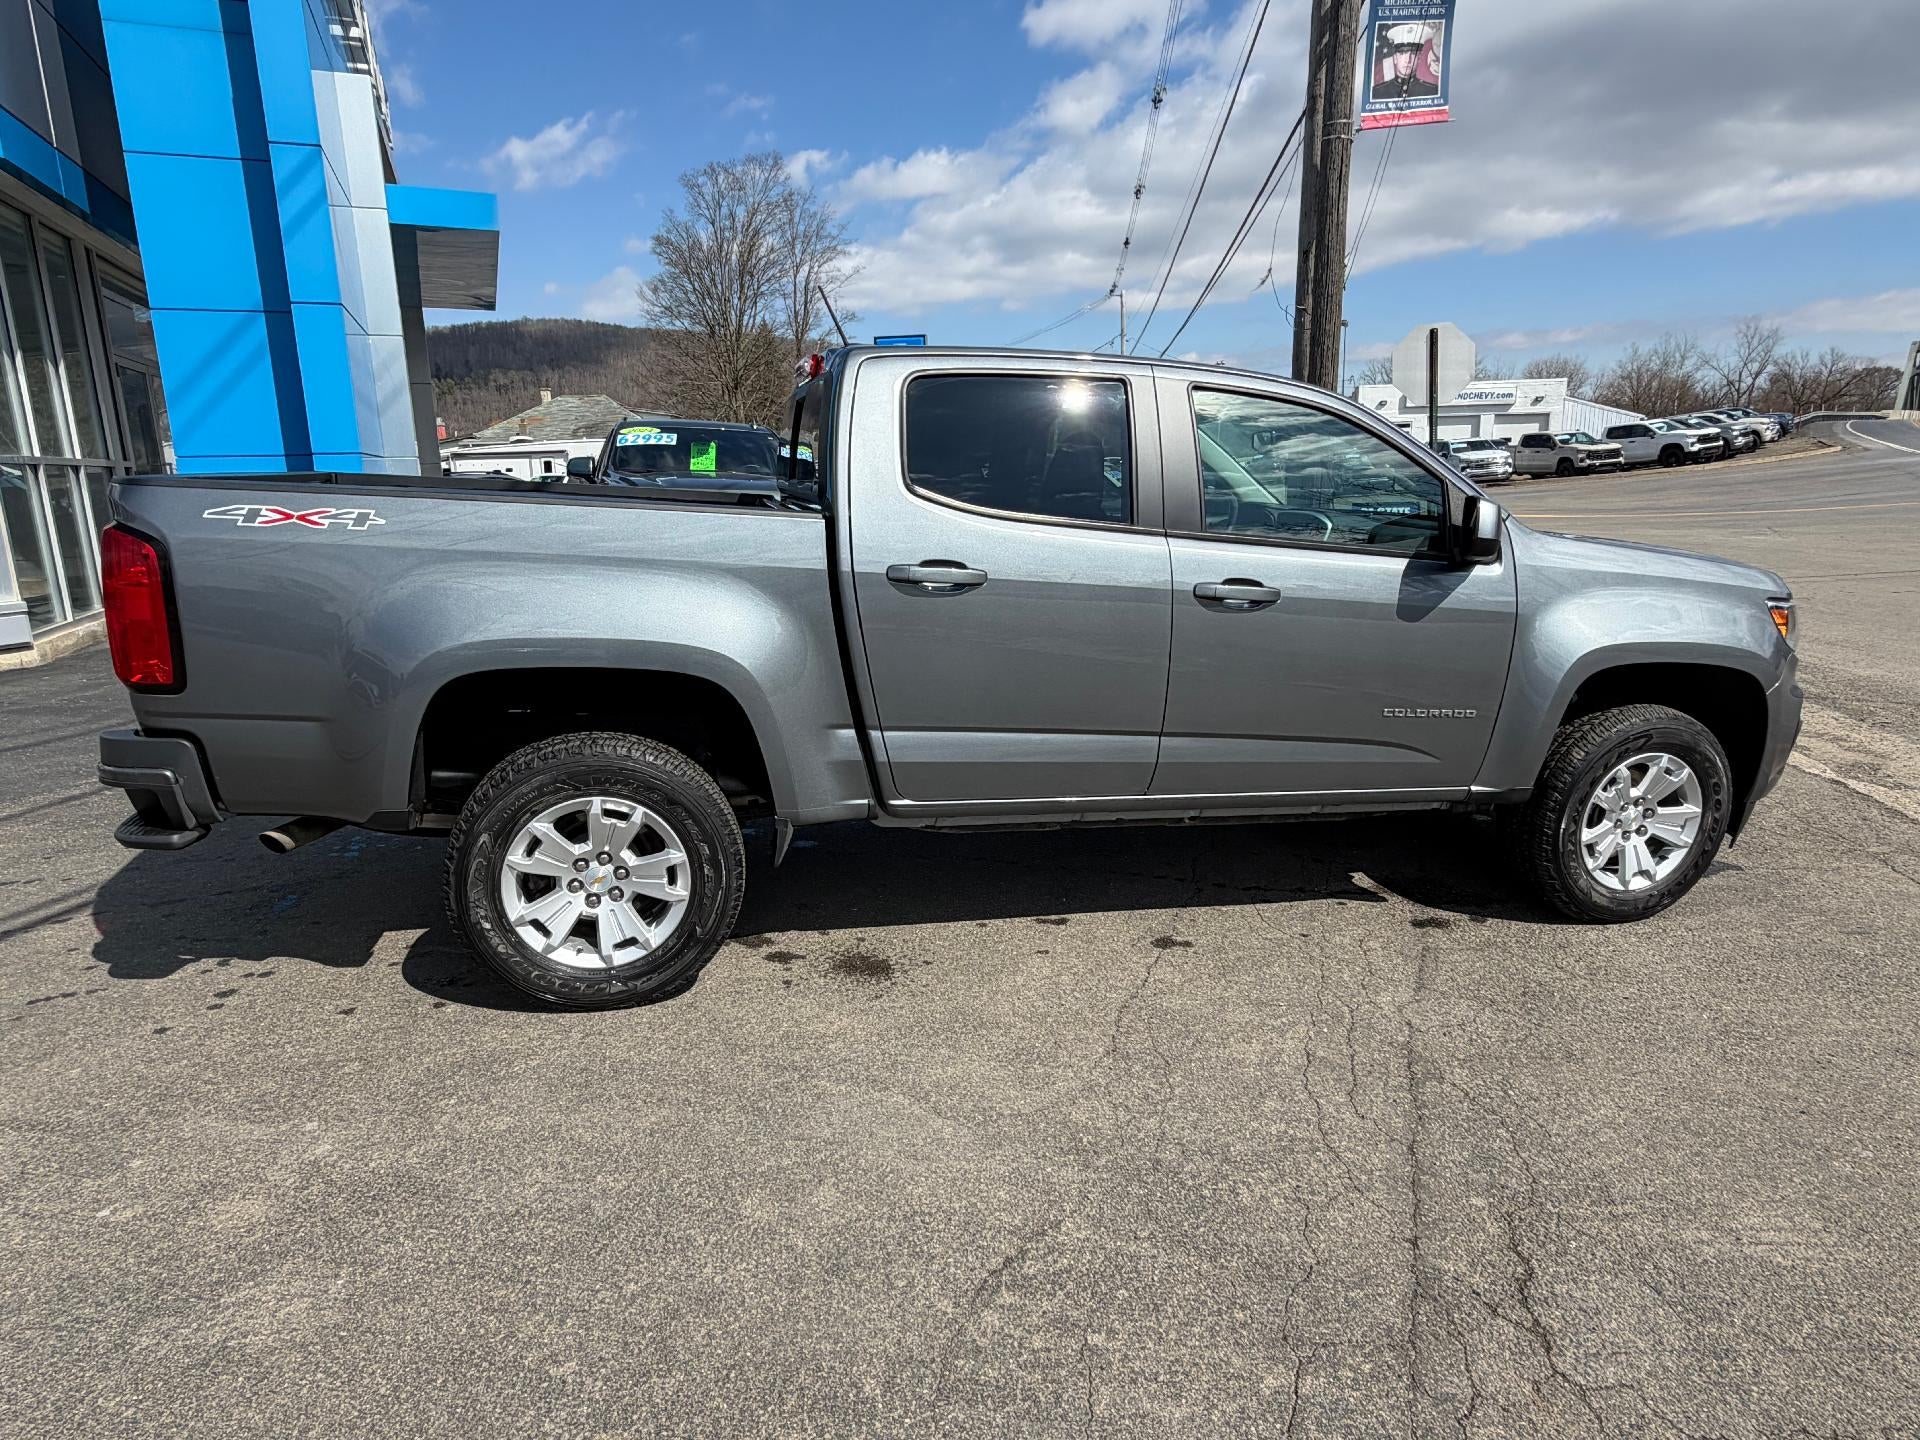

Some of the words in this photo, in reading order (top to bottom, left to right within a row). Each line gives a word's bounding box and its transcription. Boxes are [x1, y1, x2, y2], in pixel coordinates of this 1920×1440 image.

[1392, 8, 1421, 16] MARINE
[1422, 7, 1446, 15] CORPS
[618, 434, 675, 445] 62995
[1382, 708, 1477, 718] COLORADO
